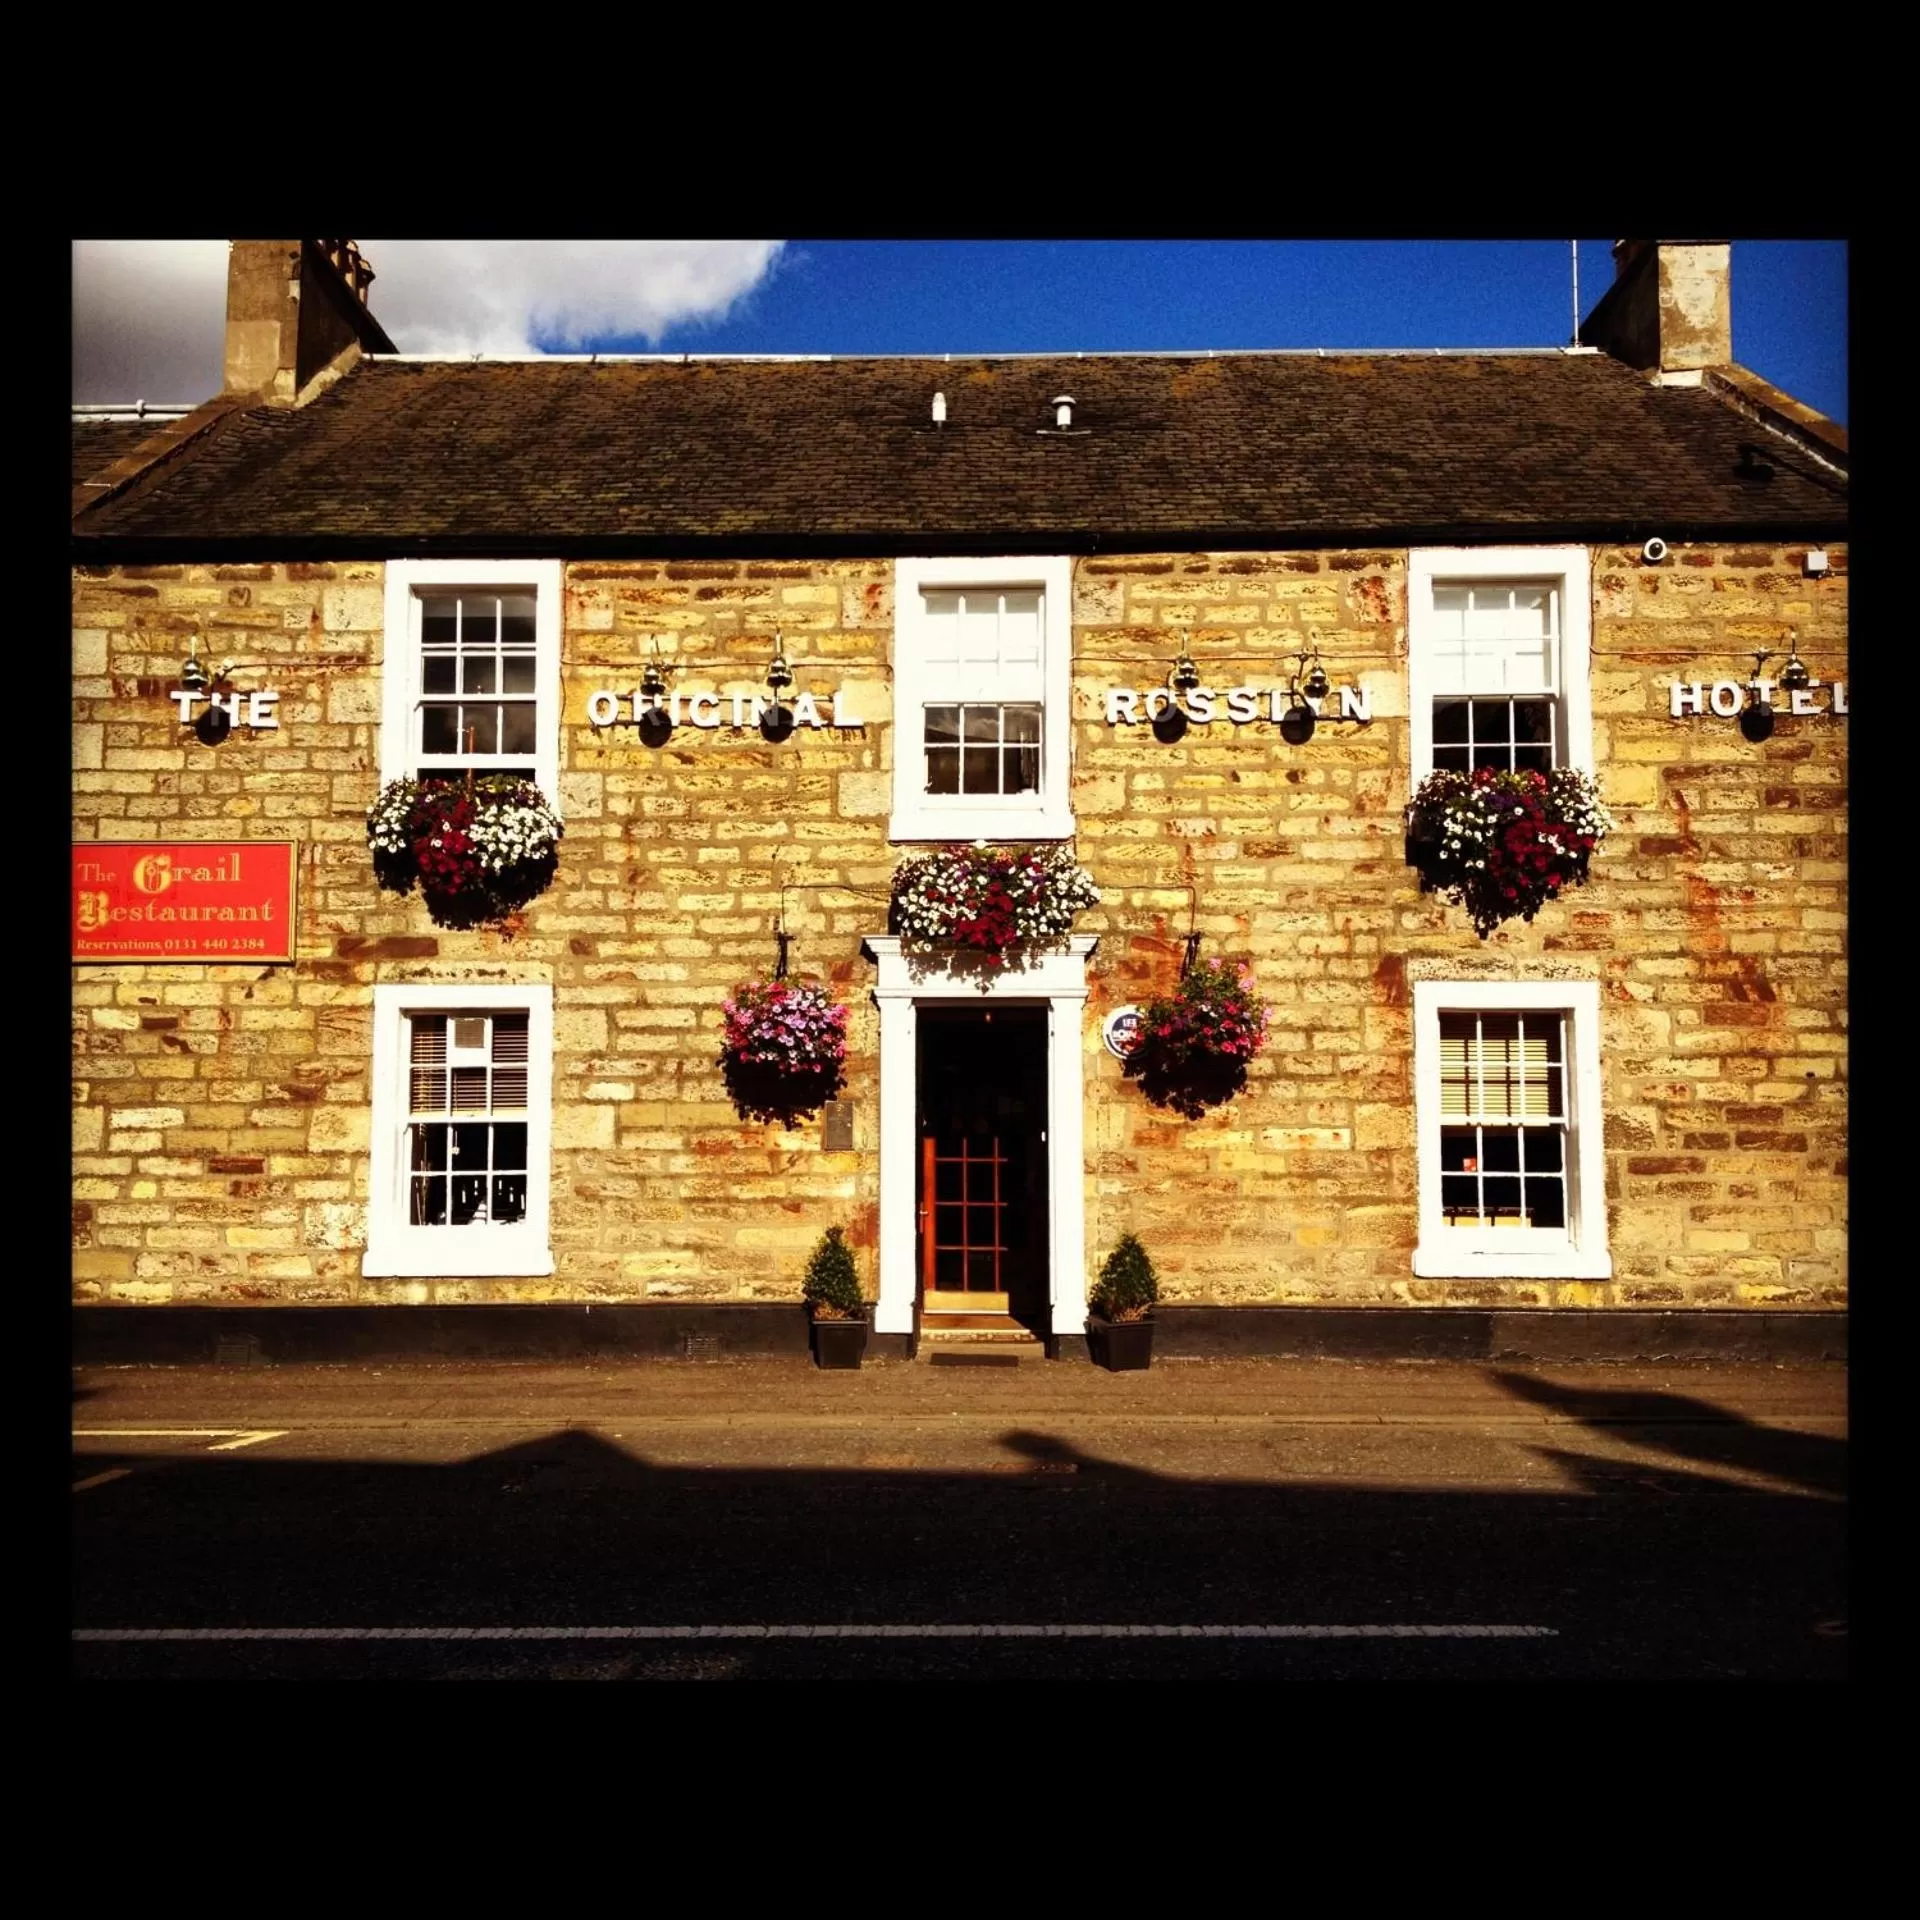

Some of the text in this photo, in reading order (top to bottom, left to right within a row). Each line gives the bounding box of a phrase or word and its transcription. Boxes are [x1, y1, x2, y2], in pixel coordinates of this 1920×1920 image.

[169, 691, 280, 727] THE
[587, 690, 864, 727] ORIGINAL
[77, 852, 241, 895] The Grail
[77, 890, 274, 932] Restaurant
[164, 939, 198, 950] 0131
[202, 938, 229, 950] 440
[231, 938, 265, 950] 2384
